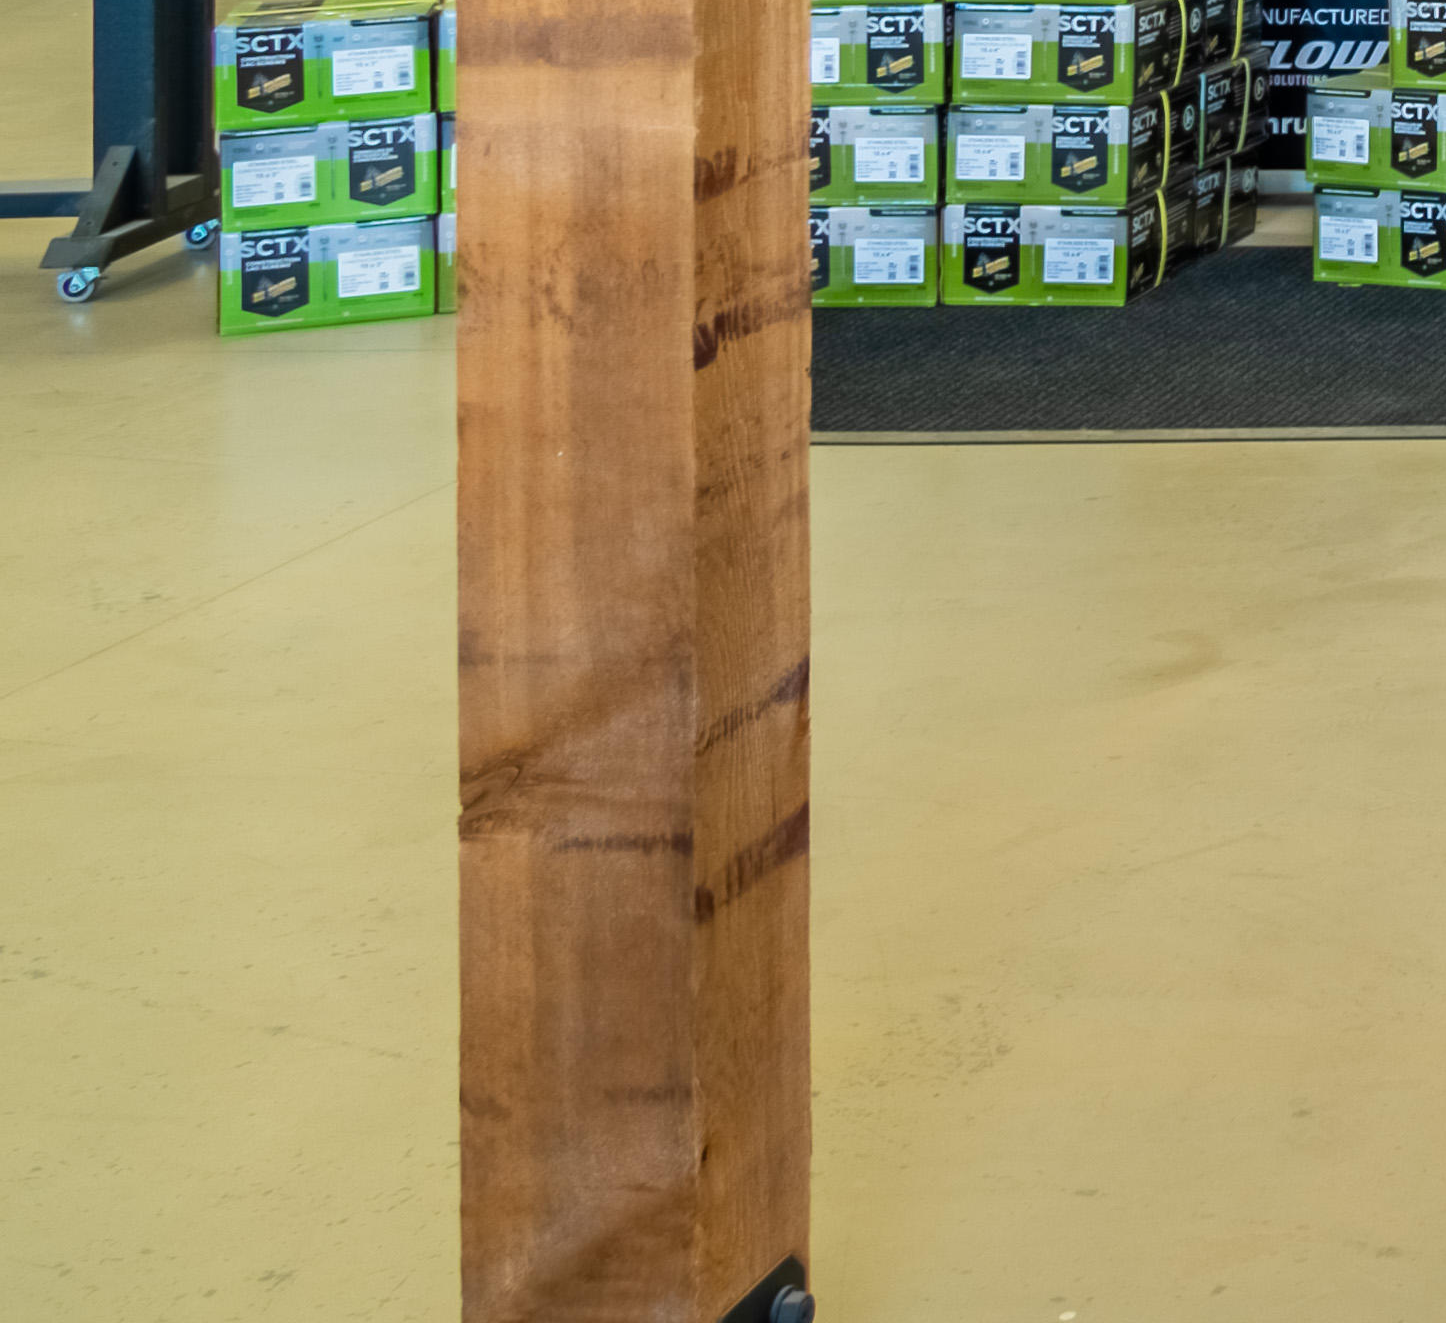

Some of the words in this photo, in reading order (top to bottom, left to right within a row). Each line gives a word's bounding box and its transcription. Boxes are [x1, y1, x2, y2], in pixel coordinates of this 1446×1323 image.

[866, 15, 925, 34] SCTX
[1058, 15, 1116, 33] SCTX
[1138, 8, 1167, 33] SCTX
[235, 32, 304, 54] SCTX
[1131, 108, 1159, 134] SCTX
[1390, 102, 1439, 121] SCTX
[1051, 115, 1110, 134] SCTX
[348, 126, 415, 147] SCTX
[963, 217, 1021, 235] SCTX
[1132, 208, 1155, 233] SCTX
[240, 237, 310, 258] SCTX
